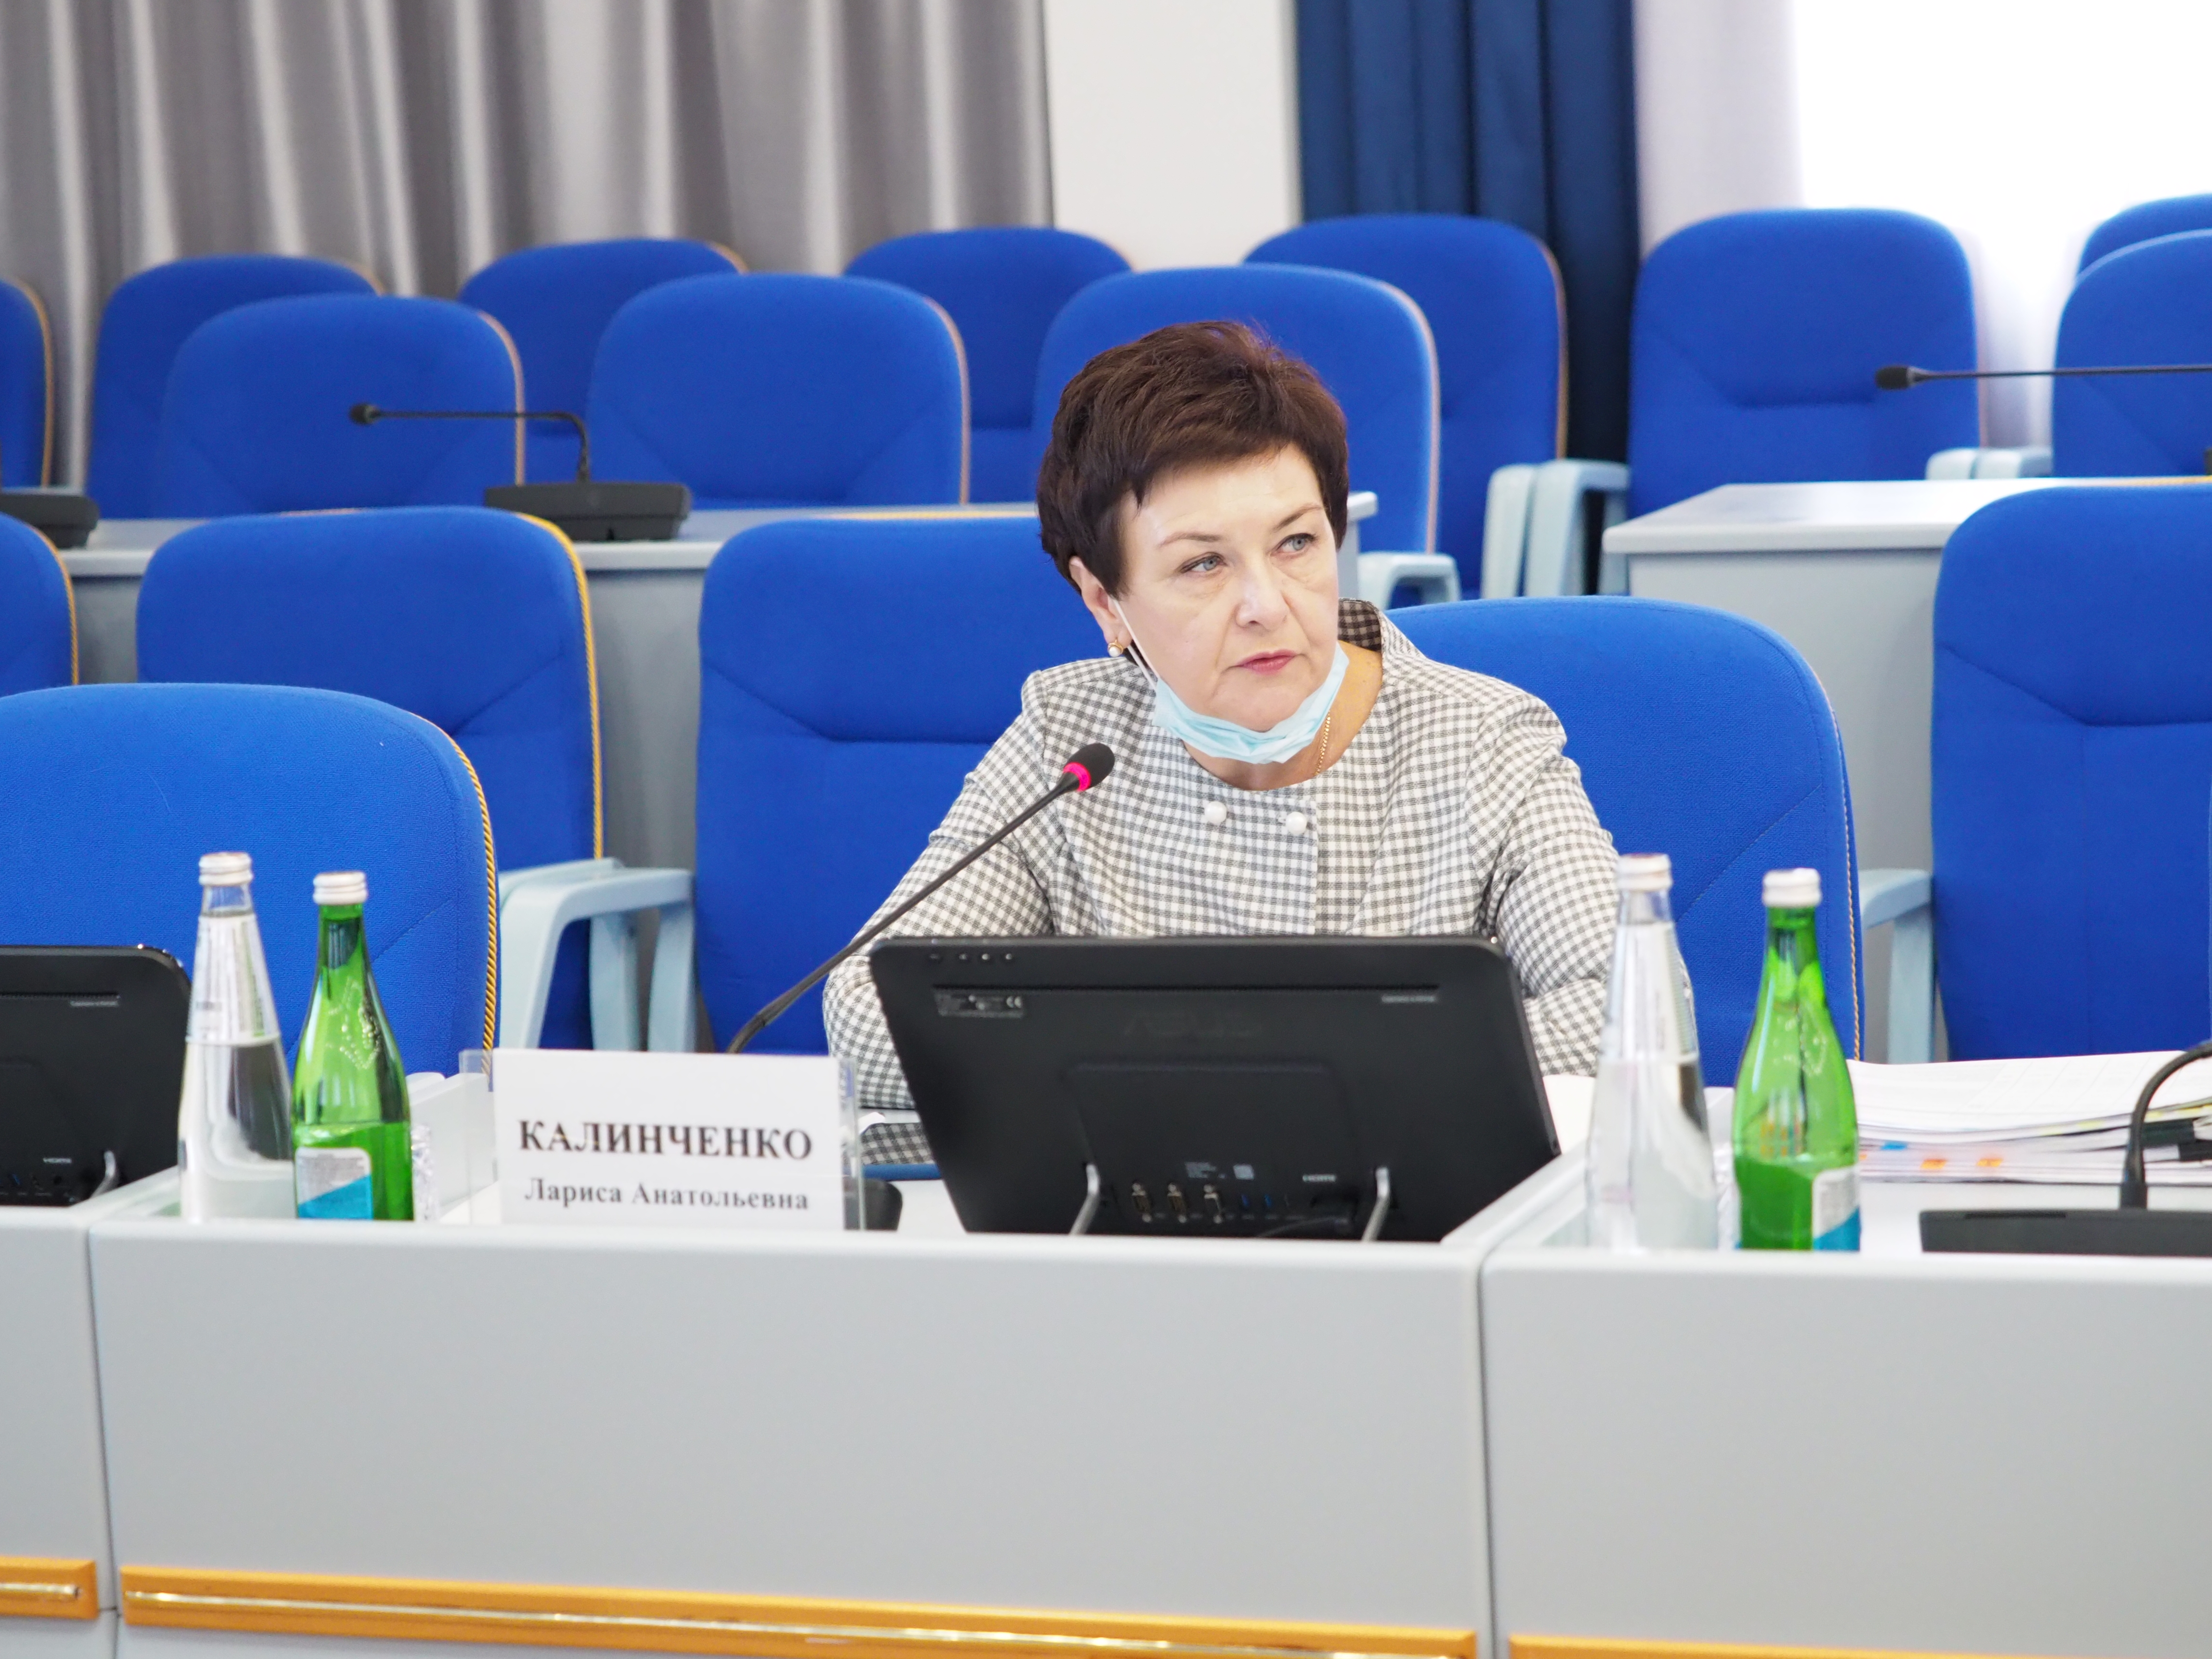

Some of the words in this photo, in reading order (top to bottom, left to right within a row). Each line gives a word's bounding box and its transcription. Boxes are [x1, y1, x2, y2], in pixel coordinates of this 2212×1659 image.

[520, 1120, 812, 1159] КАЛИНЧЕНКО
[525, 1178, 622, 1208] Лариса
[633, 1183, 808, 1210] Анатольевна
